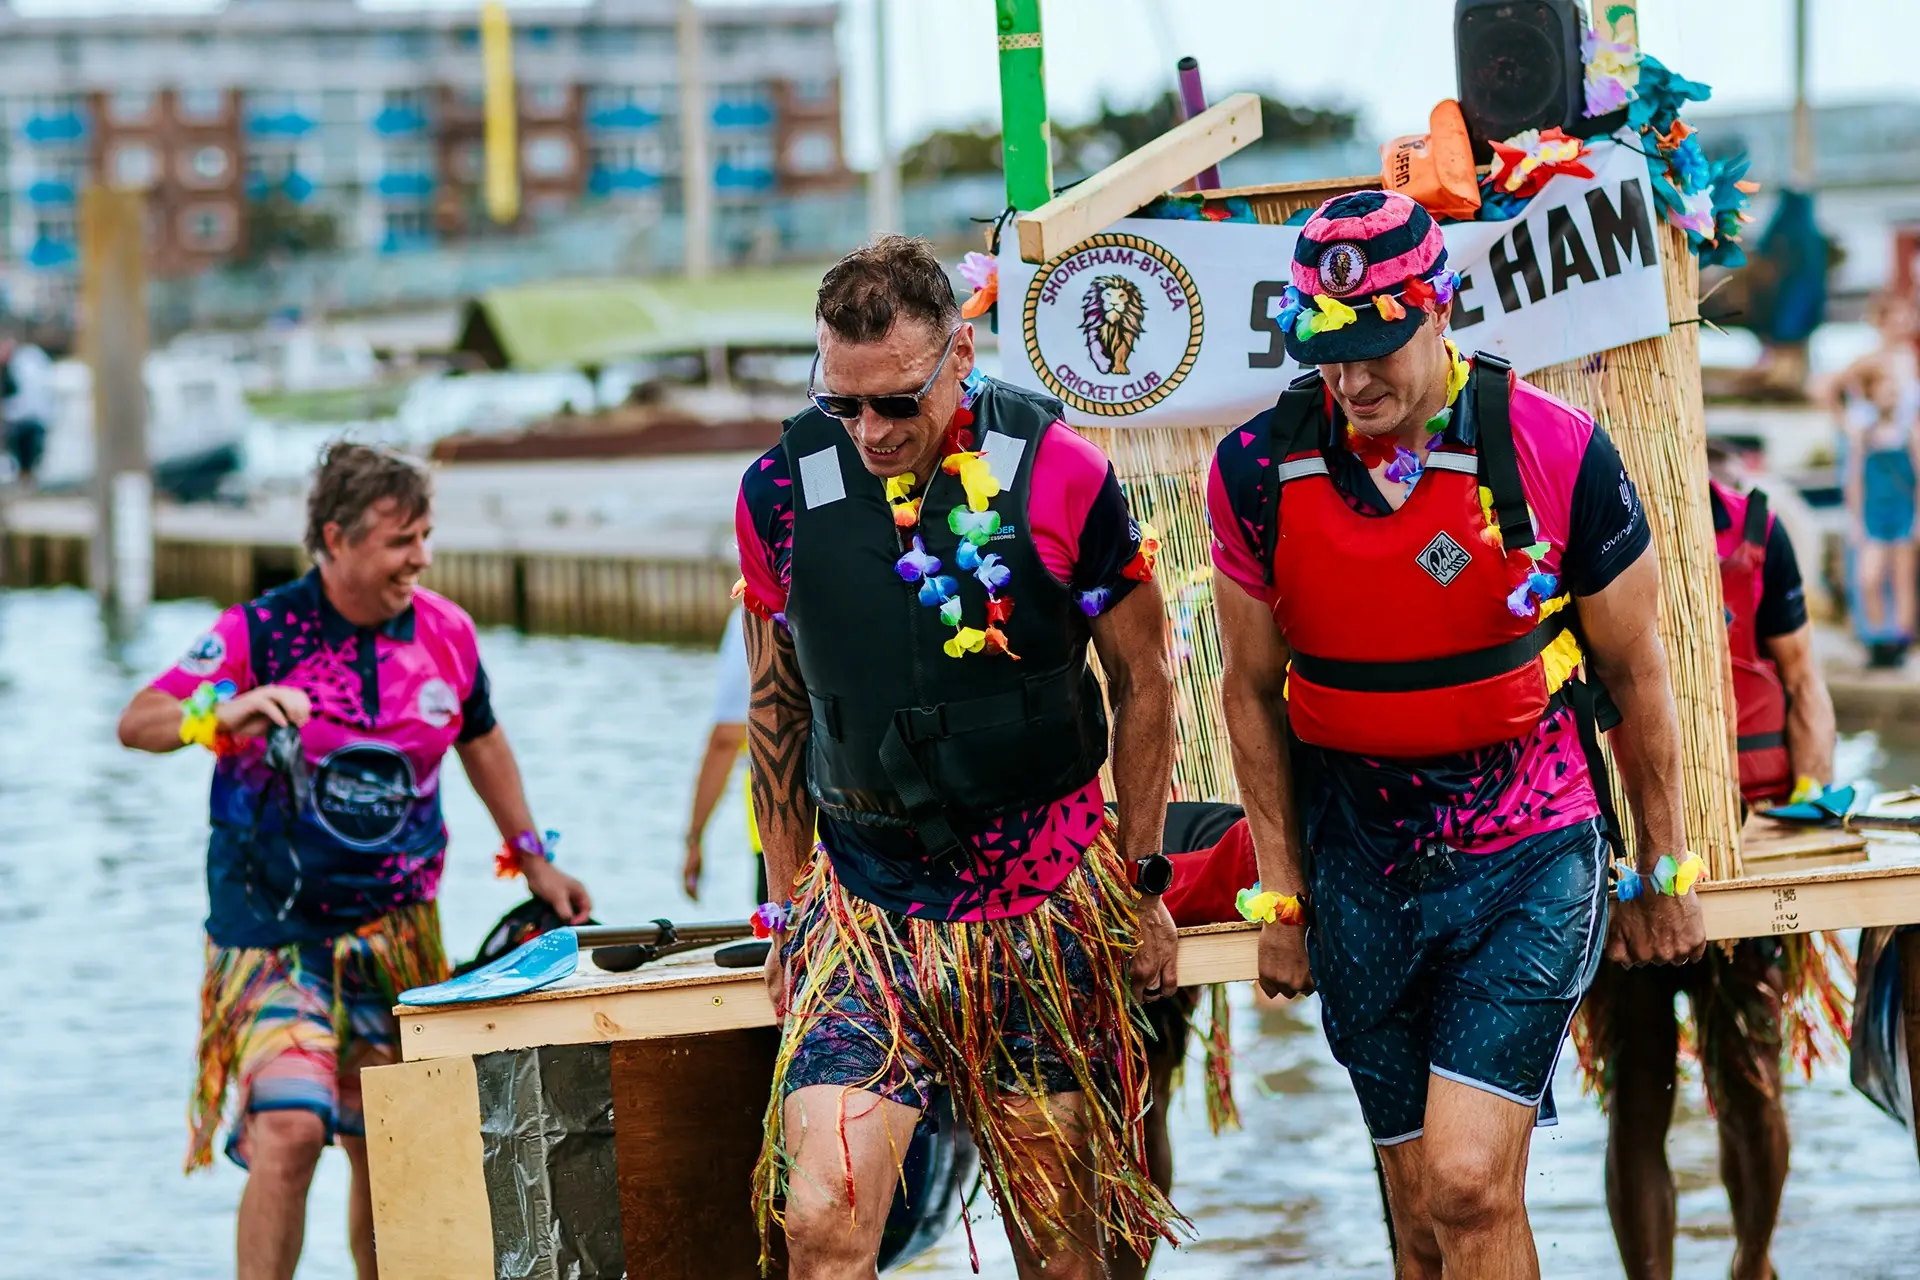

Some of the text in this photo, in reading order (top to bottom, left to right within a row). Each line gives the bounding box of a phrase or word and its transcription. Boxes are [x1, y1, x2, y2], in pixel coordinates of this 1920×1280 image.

[1041, 248, 1185, 311] SHOREHAM-BY-SEA
[1055, 364, 1162, 401] CRICKET CLUB
[995, 526, 1015, 534] DER
